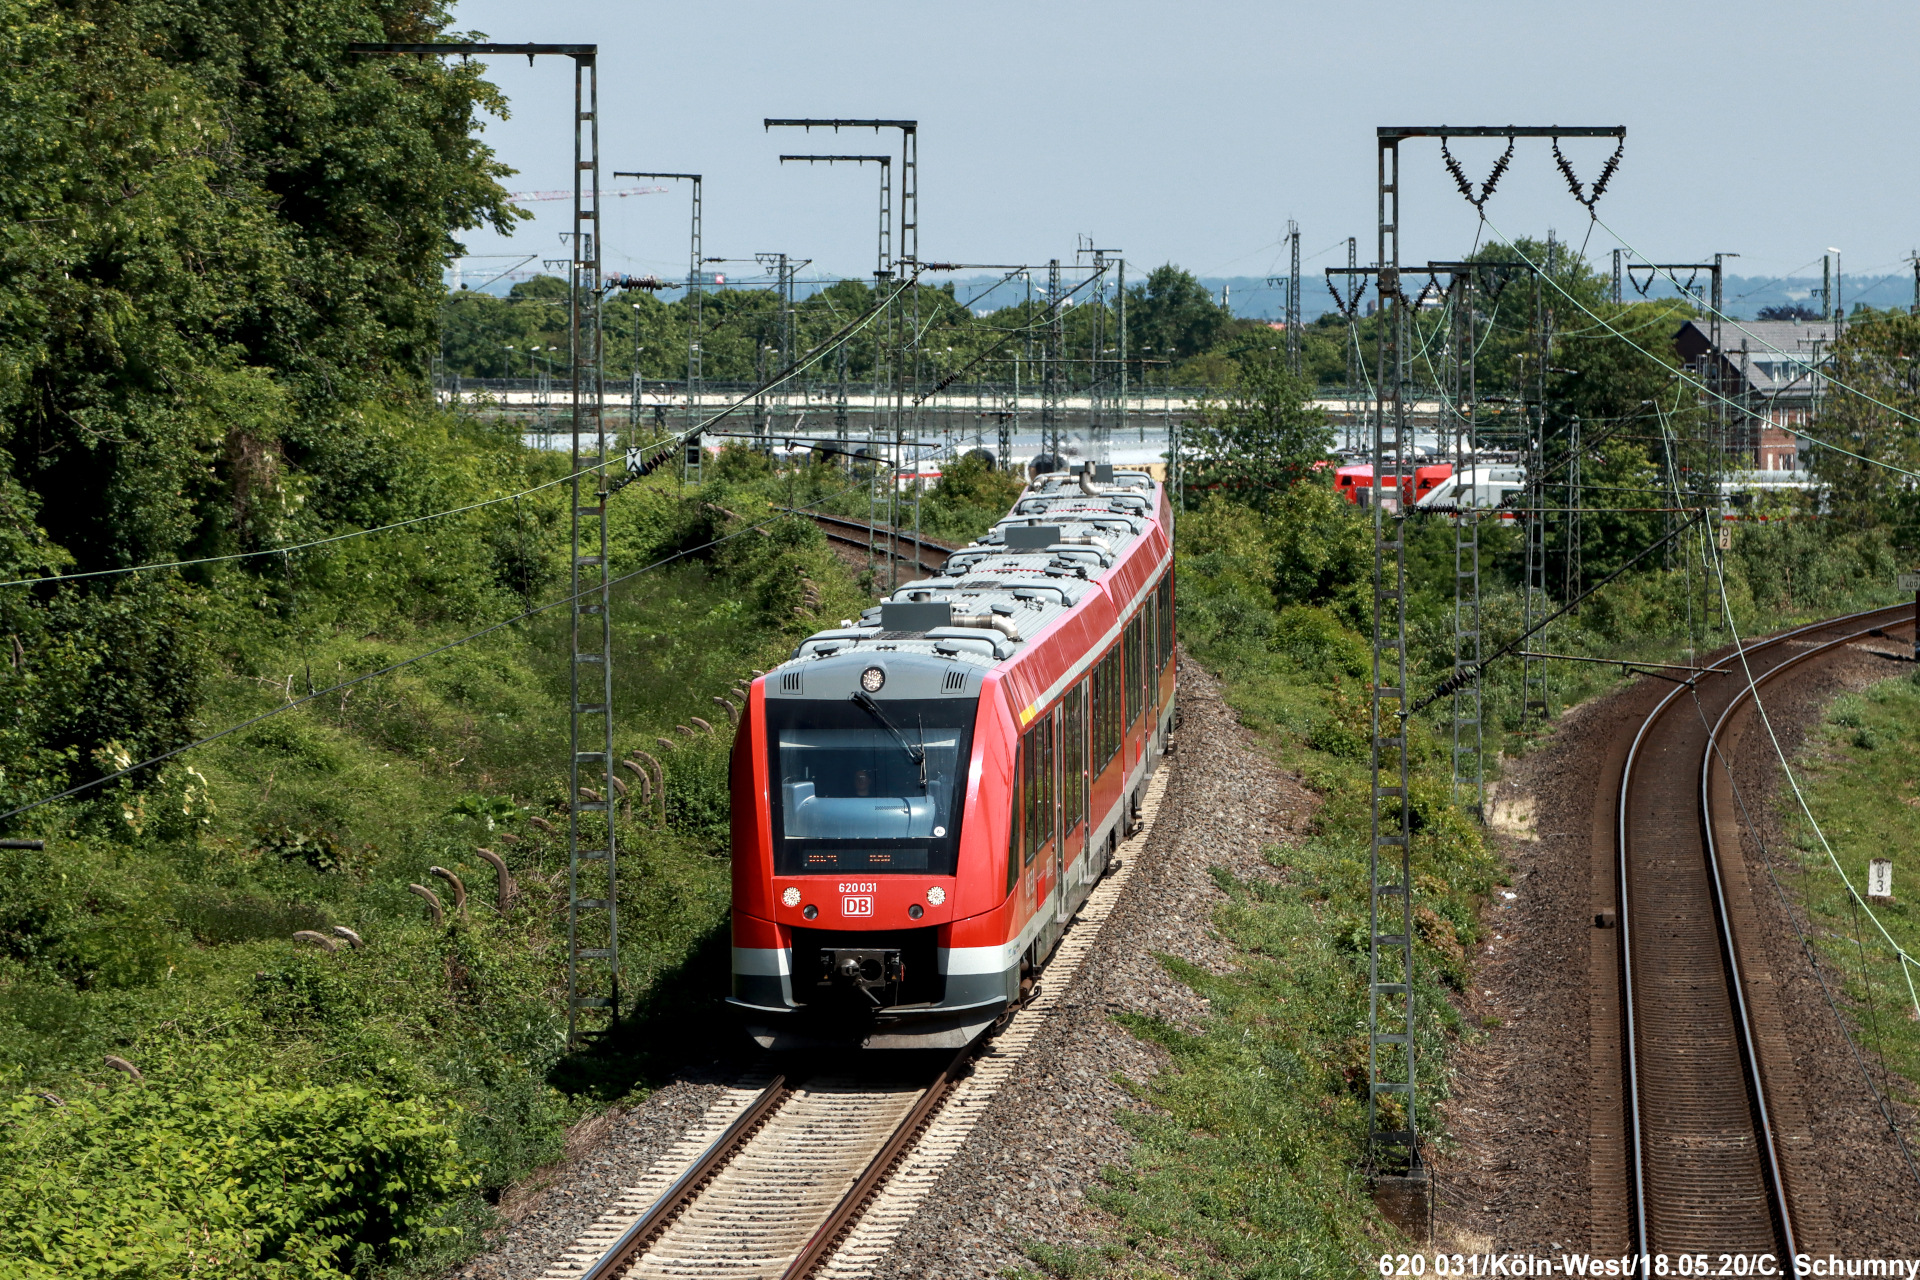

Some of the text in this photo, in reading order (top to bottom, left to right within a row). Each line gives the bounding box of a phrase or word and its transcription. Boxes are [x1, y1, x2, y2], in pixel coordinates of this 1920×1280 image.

[1722, 538, 1728, 547] 2
[1876, 880, 1884, 892] 3
[846, 899, 869, 913] DB
